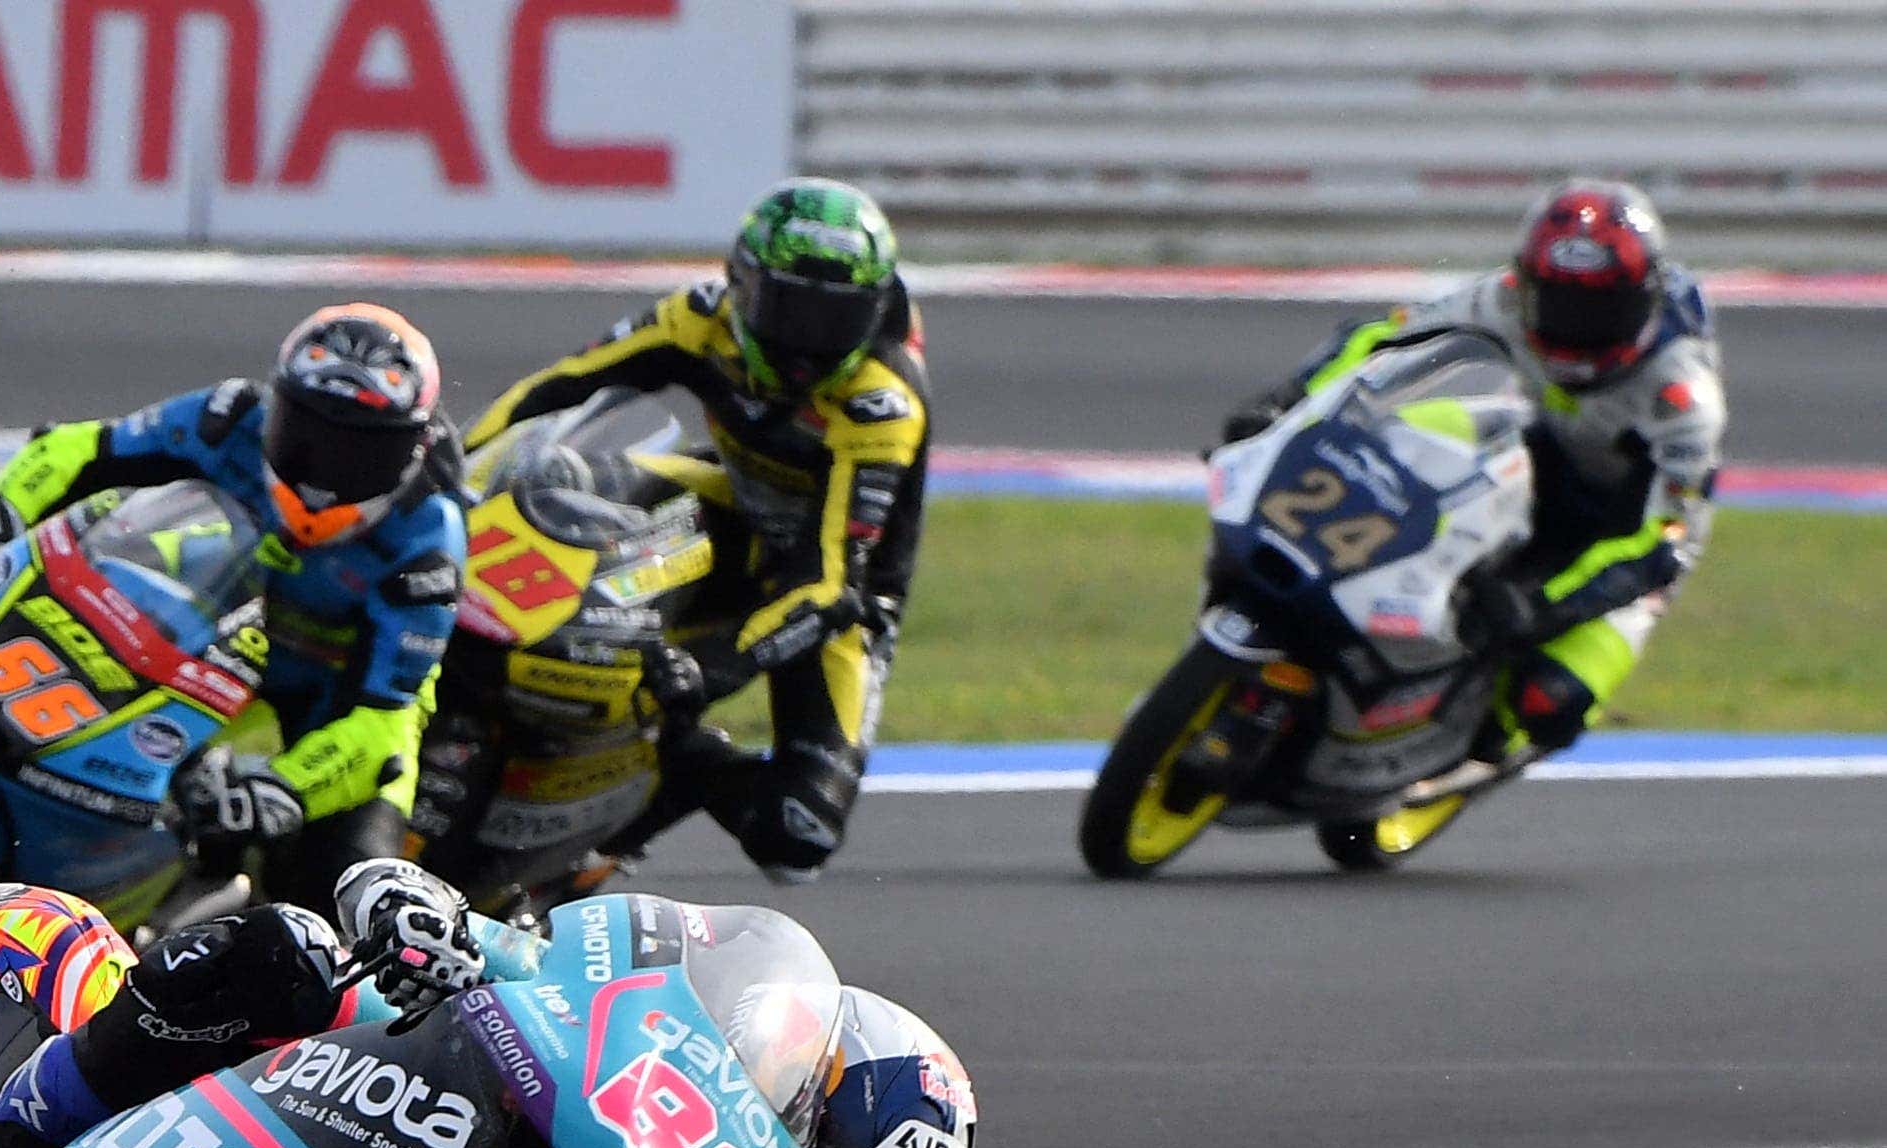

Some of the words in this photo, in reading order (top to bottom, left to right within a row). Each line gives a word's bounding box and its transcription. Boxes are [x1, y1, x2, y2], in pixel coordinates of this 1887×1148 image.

[1261, 468, 1398, 574] 24
[468, 525, 581, 612] 18
[481, 1010, 543, 1097] solunion
[316, 1105, 325, 1121] &
[325, 1107, 368, 1143] Shutter
